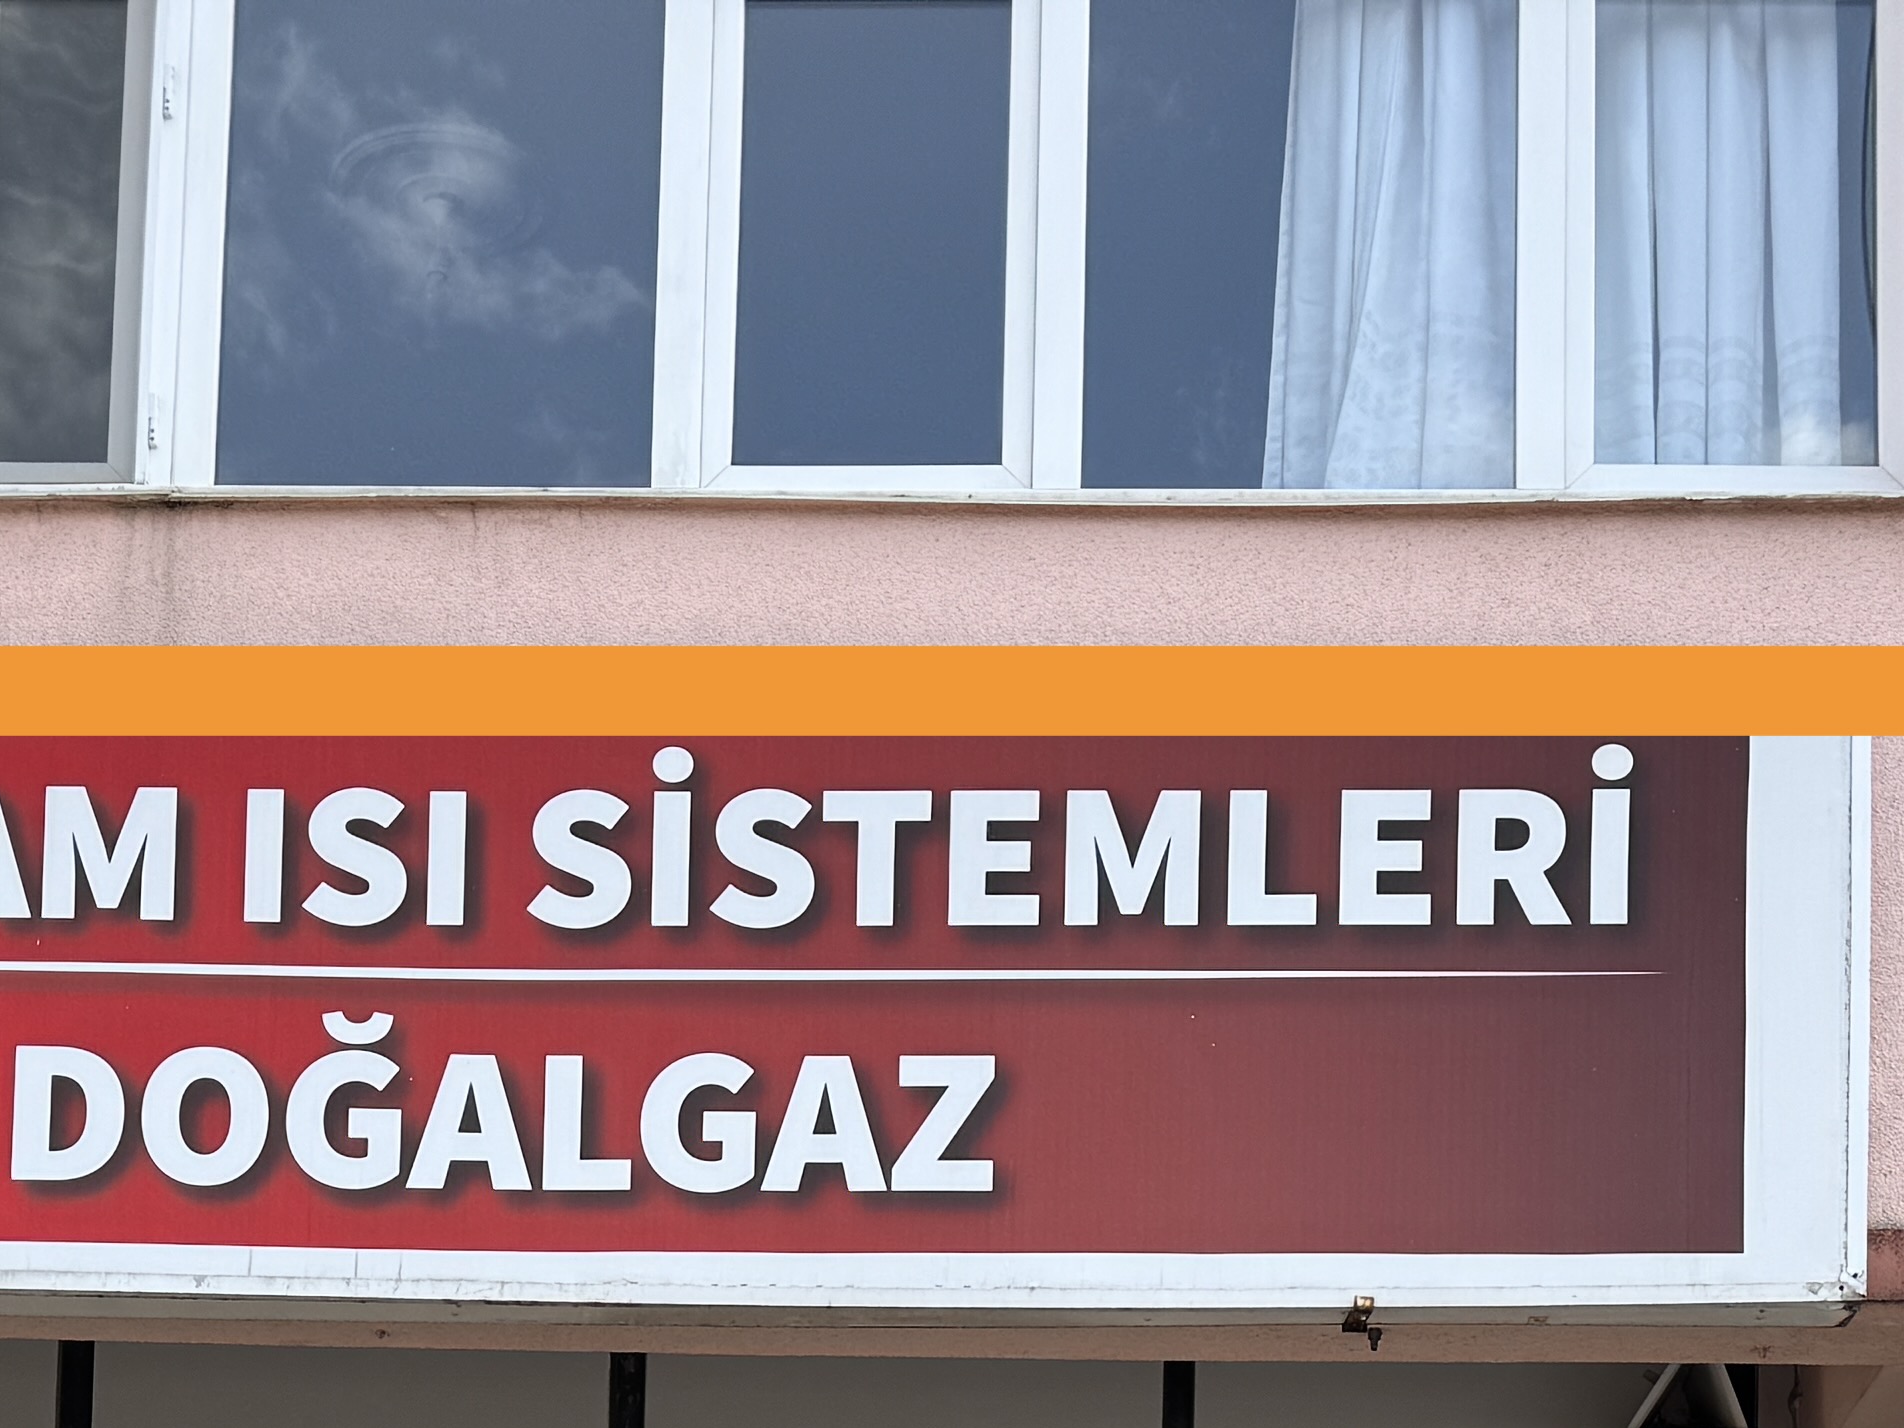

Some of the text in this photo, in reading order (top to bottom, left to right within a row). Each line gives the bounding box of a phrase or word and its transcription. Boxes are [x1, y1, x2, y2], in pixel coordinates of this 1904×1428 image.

[243, 785, 467, 927] ISI
[526, 743, 1634, 930] SİSTEMLERİ
[11, 1010, 996, 1195] DOĞALGAZ
